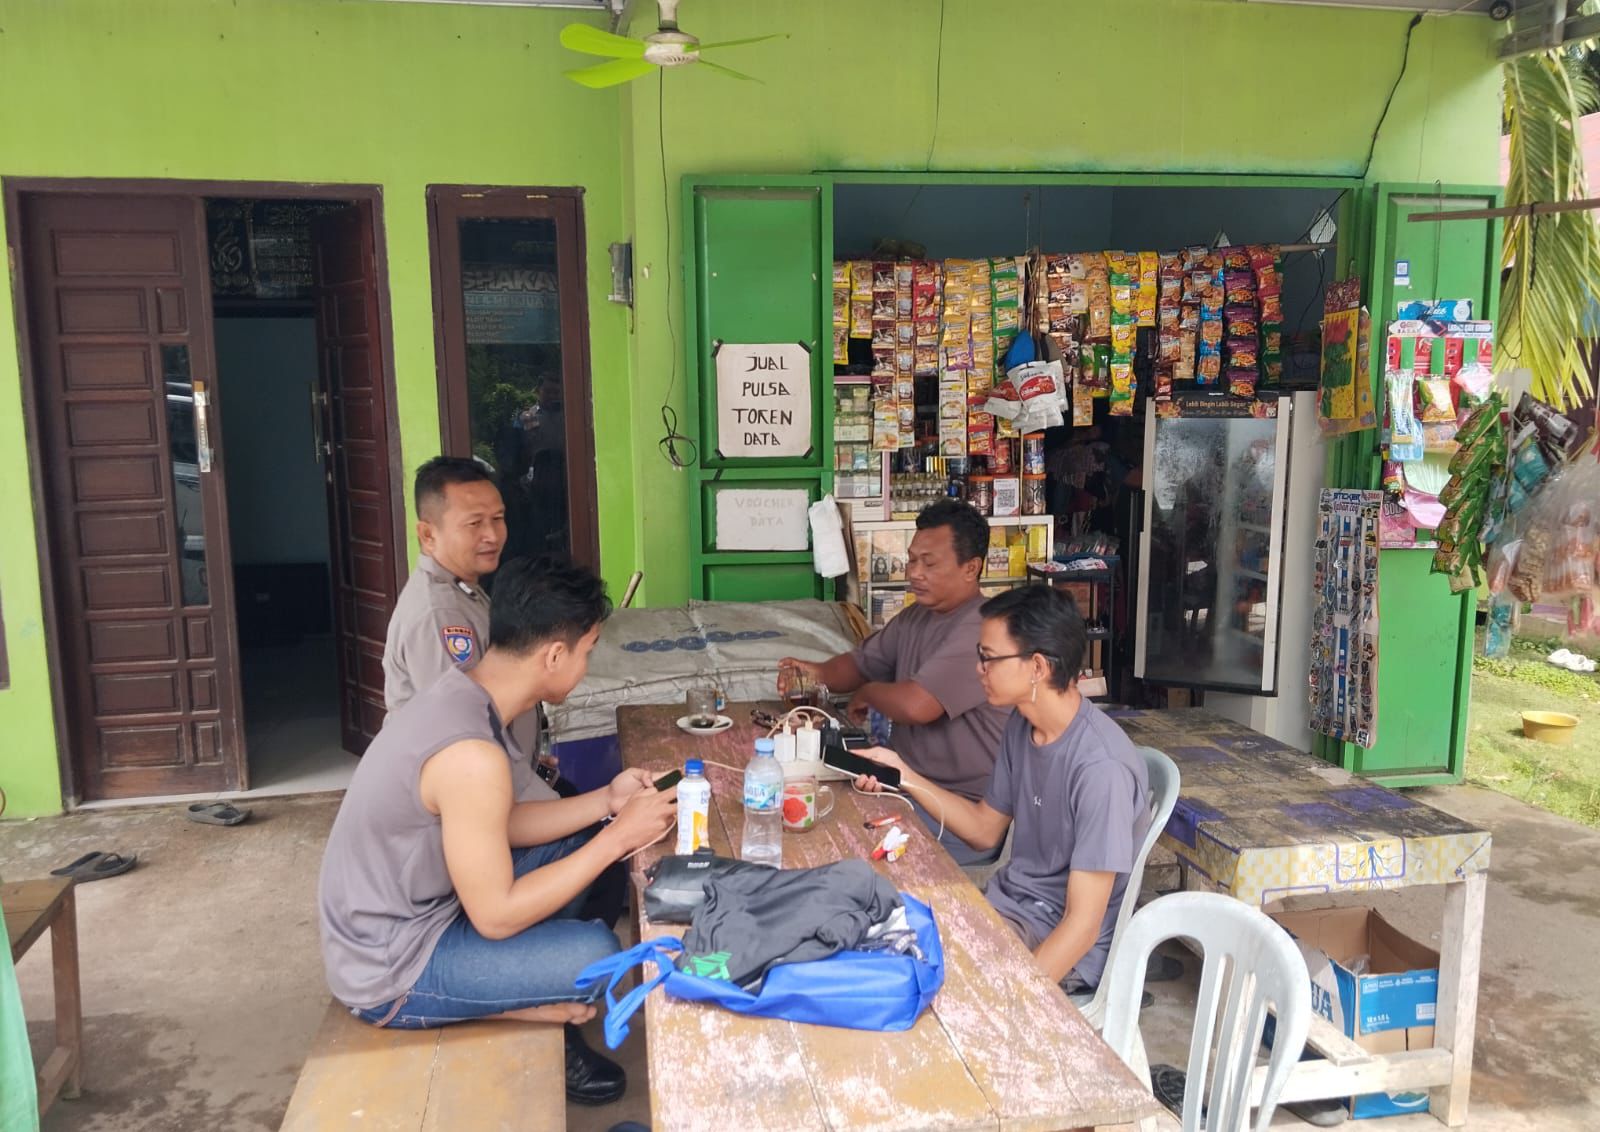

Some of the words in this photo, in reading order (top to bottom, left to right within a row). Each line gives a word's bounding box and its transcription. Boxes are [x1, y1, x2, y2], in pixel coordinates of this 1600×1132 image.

[746, 356, 790, 372] JUAL
[742, 381, 791, 397] PULSA
[731, 408, 793, 425] TOKEN
[743, 432, 781, 446] DATA
